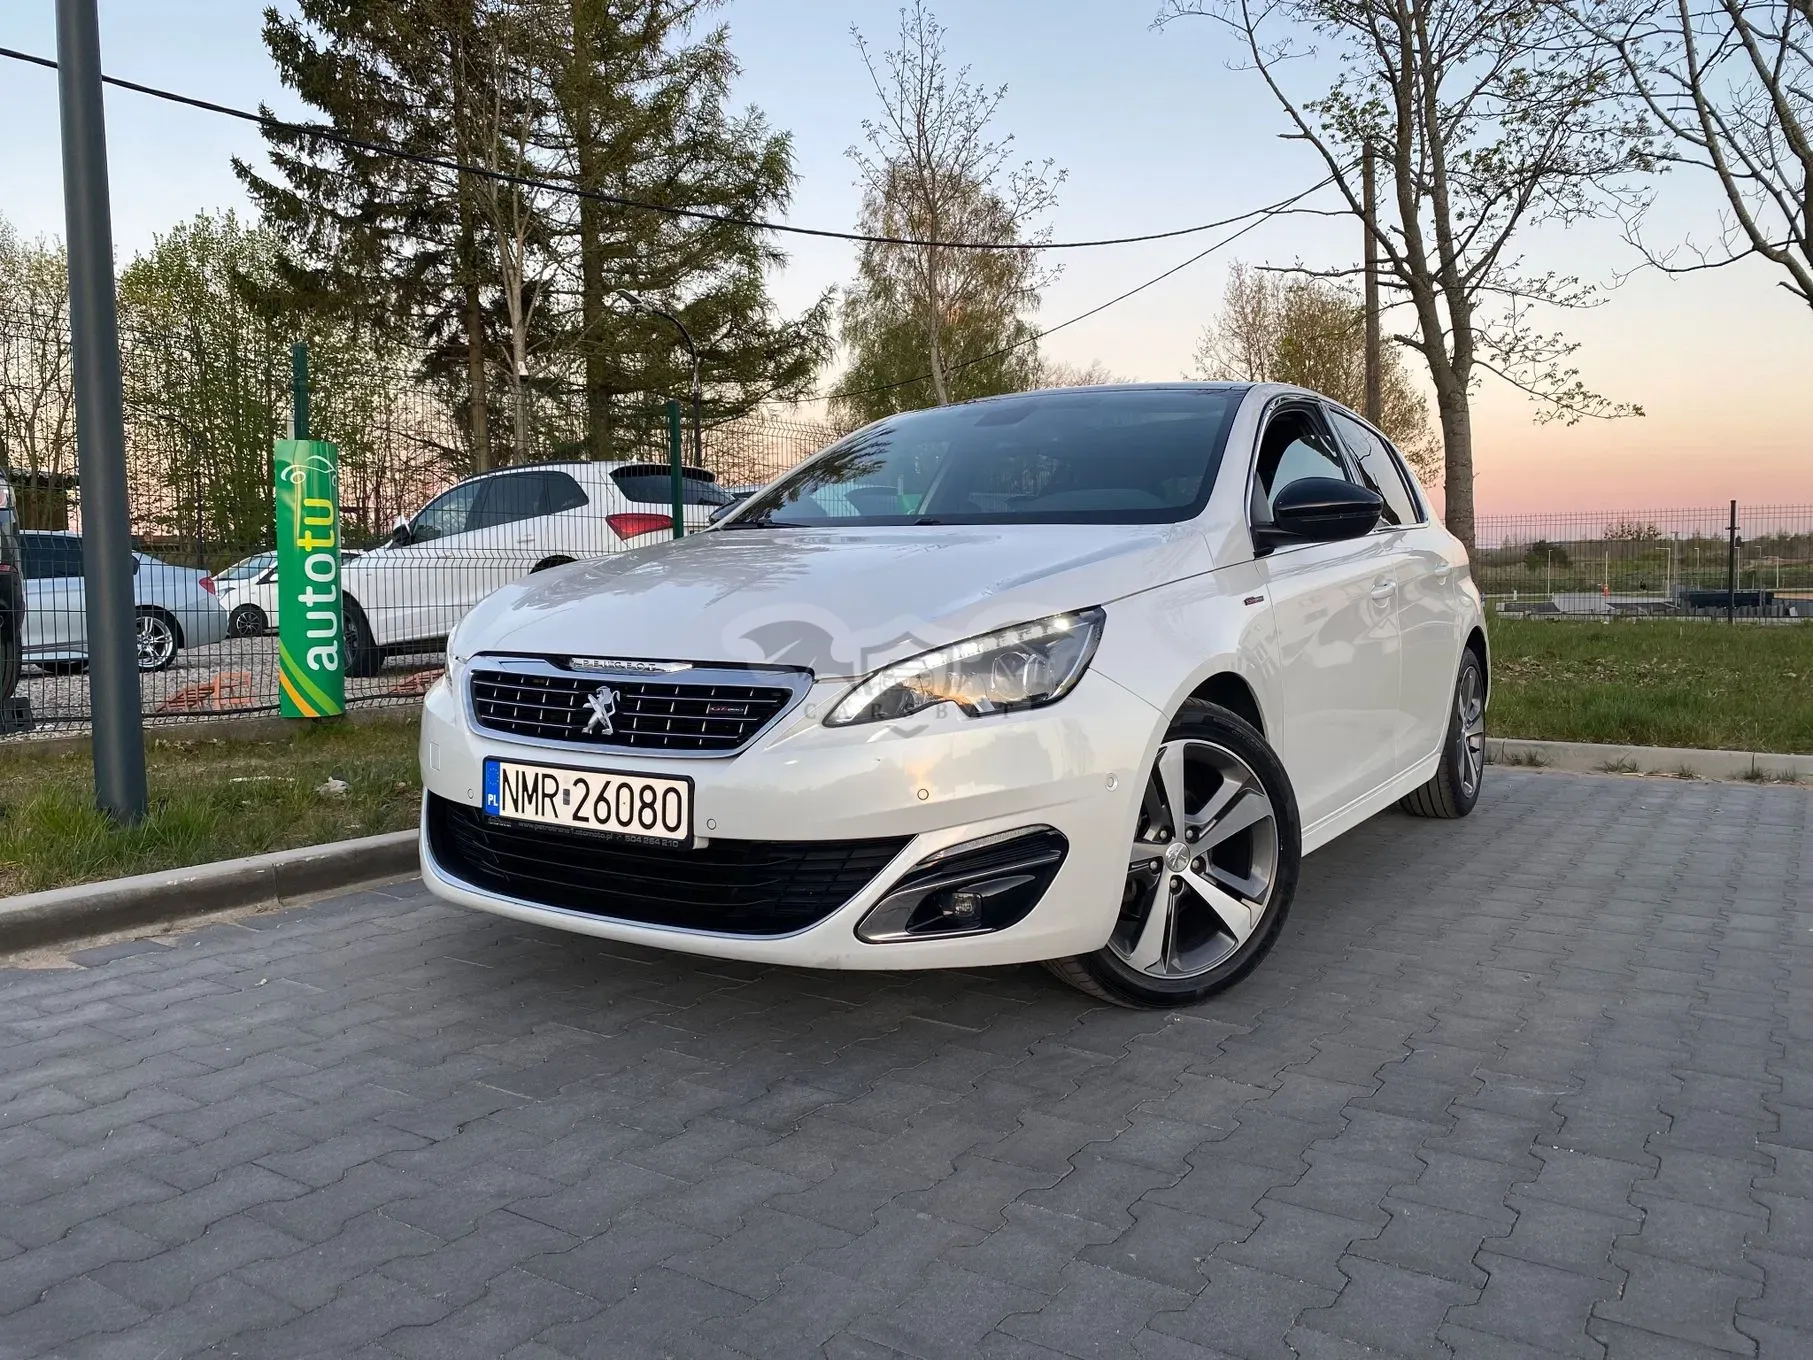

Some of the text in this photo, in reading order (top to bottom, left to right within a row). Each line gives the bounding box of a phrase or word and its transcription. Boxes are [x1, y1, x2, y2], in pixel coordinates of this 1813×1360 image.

[297, 497, 339, 672] autotu
[583, 659, 657, 672] PEUGEOT
[487, 793, 499, 807] PL
[502, 768, 683, 833] NMR 26080
